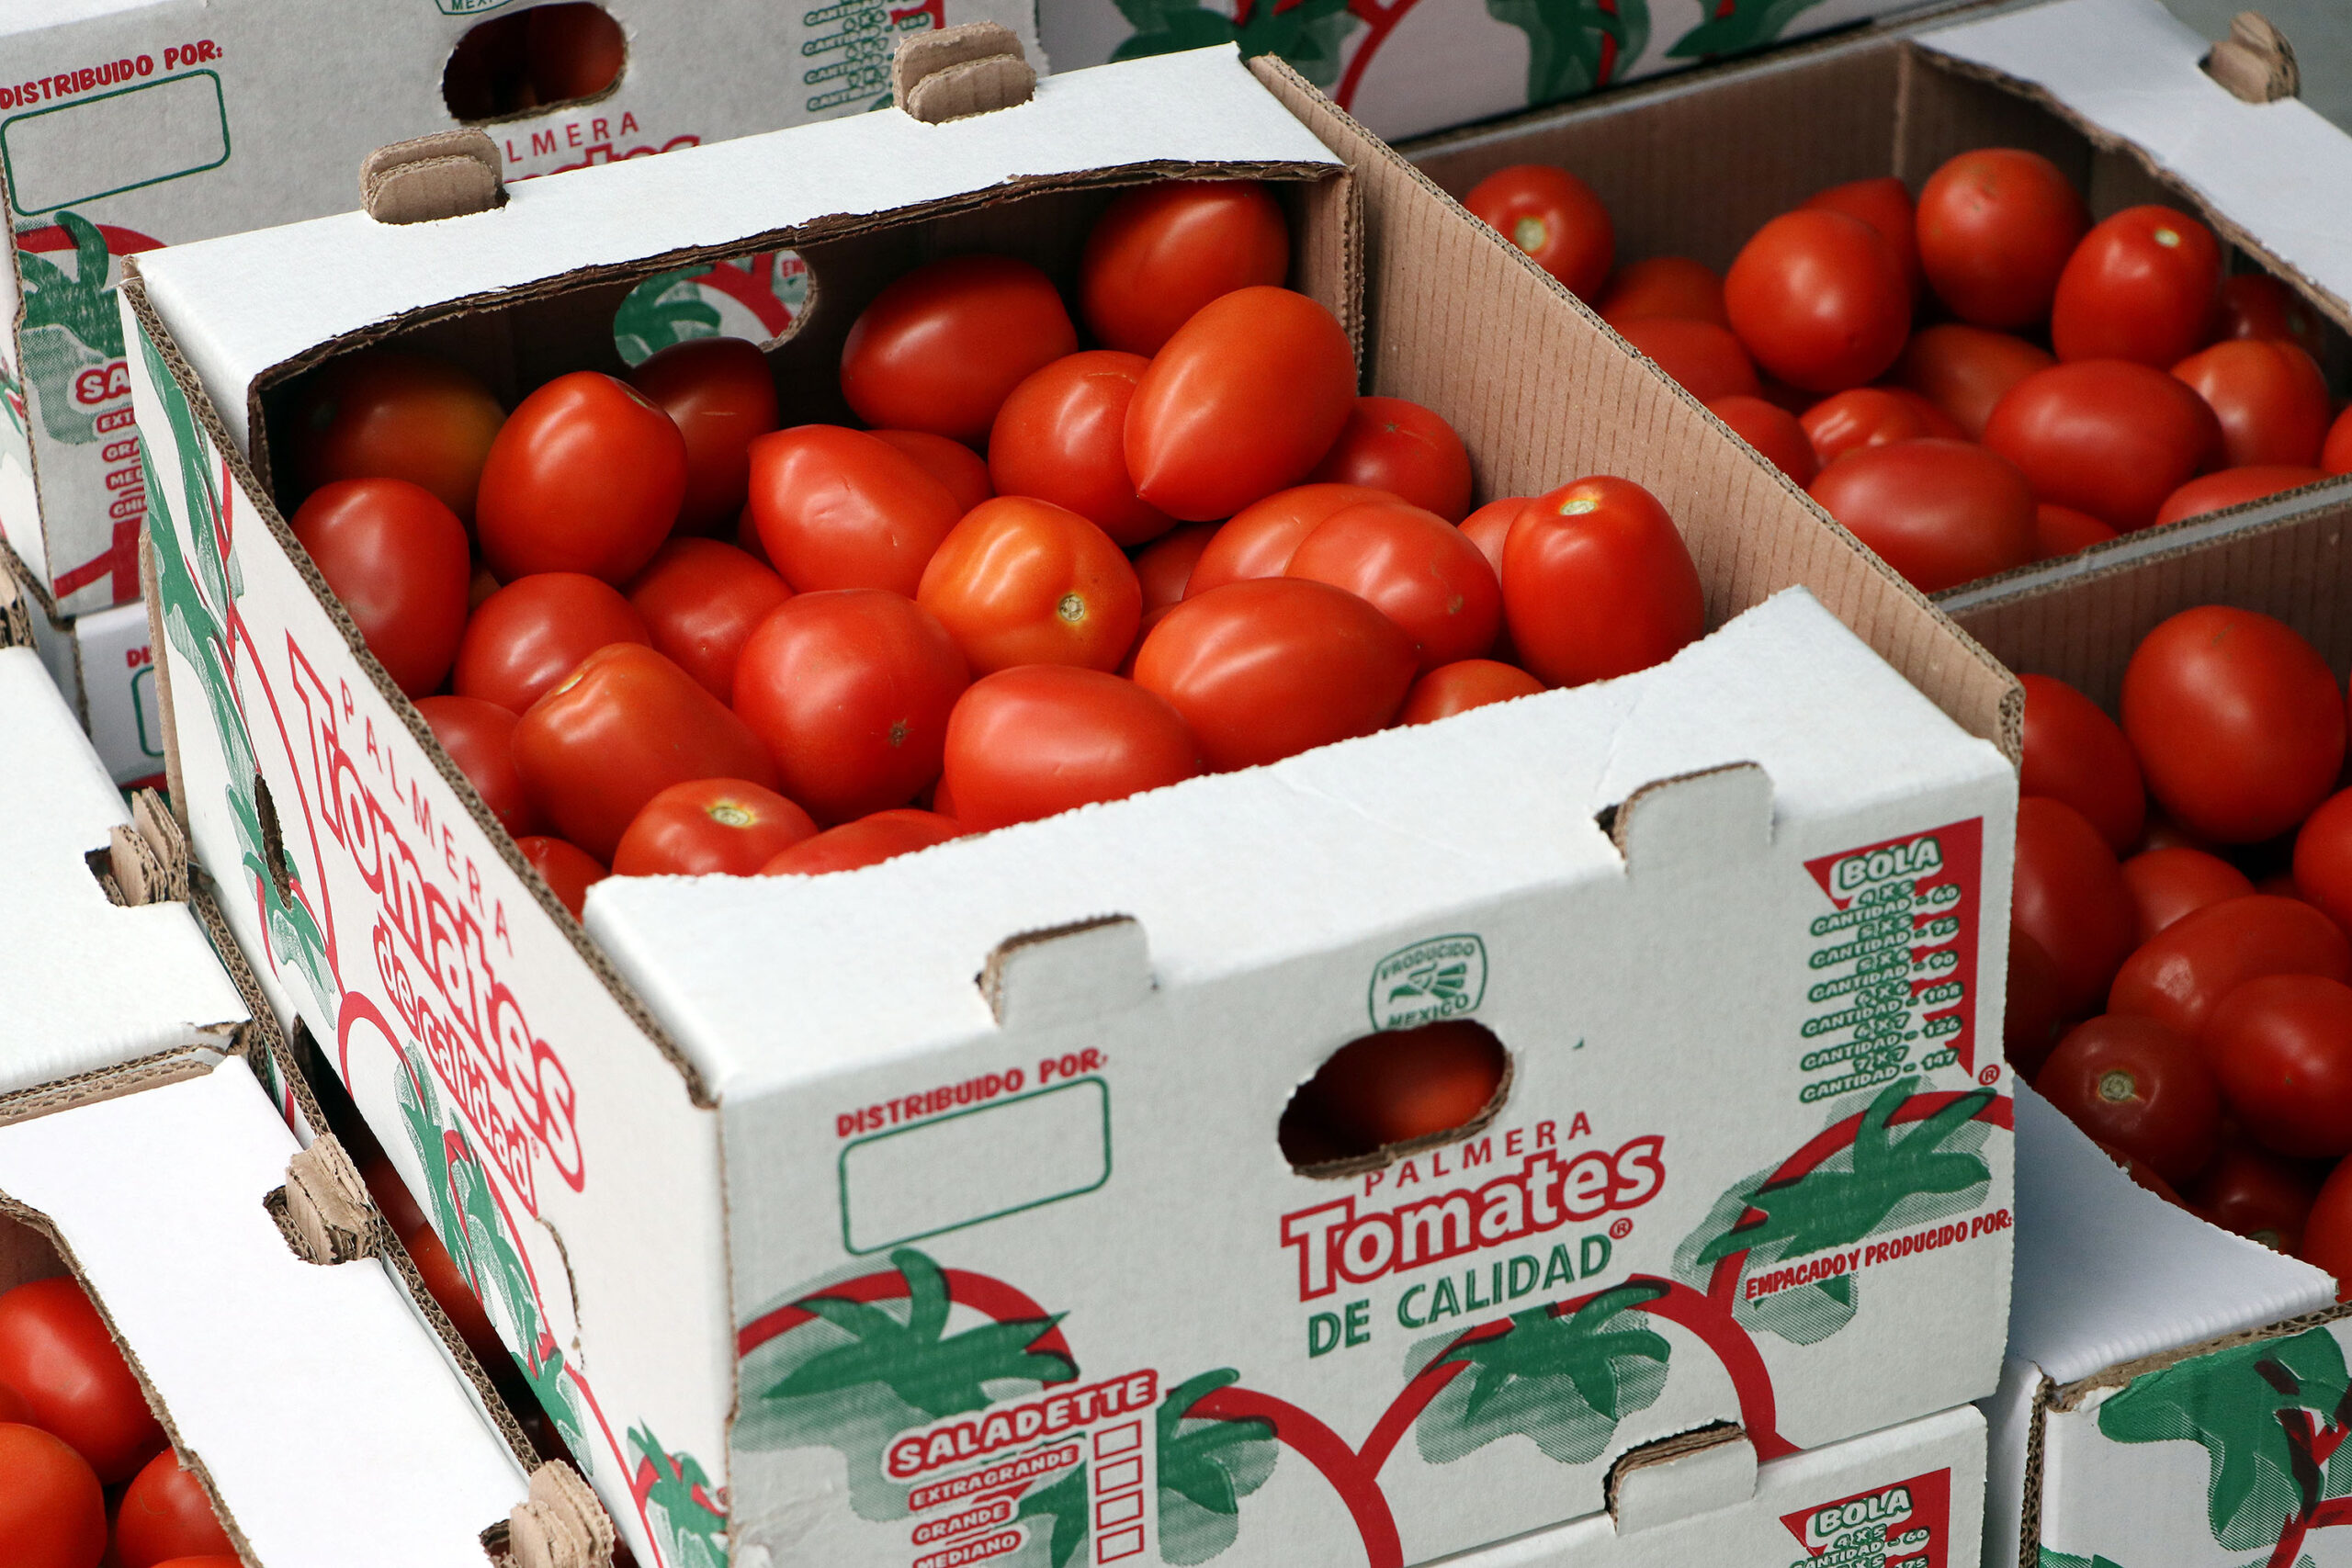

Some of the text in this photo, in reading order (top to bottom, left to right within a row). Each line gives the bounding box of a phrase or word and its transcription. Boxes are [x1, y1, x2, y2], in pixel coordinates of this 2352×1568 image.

[0, 39, 223, 109] DISTRIBUIDO POR:
[506, 111, 639, 164] LMERA
[340, 676, 514, 959] PALMERA
[1839, 837, 1943, 890] BOLA
[285, 626, 586, 1193] Tomates
[1810, 898, 1912, 936] CANTIDAD
[1932, 884, 1961, 905] 60
[1382, 942, 1476, 980] PRODUCIDO
[1809, 931, 1910, 969] CANTIDAD
[1931, 916, 1960, 937] 75
[373, 909, 422, 1042] de
[1808, 964, 1910, 1002] CANTIDAD
[1930, 950, 1959, 970] 90
[1388, 994, 1469, 1027] MEXICO
[1801, 998, 1903, 1037] CANTIDAD
[1924, 981, 1964, 1005] 108
[1801, 1032, 1902, 1071] CANTIDAD
[1922, 1015, 1963, 1039] 126
[836, 1067, 1025, 1139] DISTRIBUIDO
[1799, 1065, 1901, 1103] CANTIDAD
[1921, 1048, 1960, 1071] 147
[1364, 1111, 1592, 1197] PALMERA
[1281, 1134, 1666, 1302] Tomates
[1865, 1221, 1968, 1267] PRODUCIDO
[1972, 1209, 2013, 1240] POR:
[1308, 1299, 1371, 1359] DE
[888, 1369, 1159, 1478] SALADETTE
[909, 1444, 1080, 1511] EXTRAGRANDE
[911, 1500, 1012, 1546] GRANDE
[1815, 1485, 1914, 1537] BOLA
[1903, 1526, 1930, 1545] 60
[912, 1530, 1023, 1568] MEDIANO
